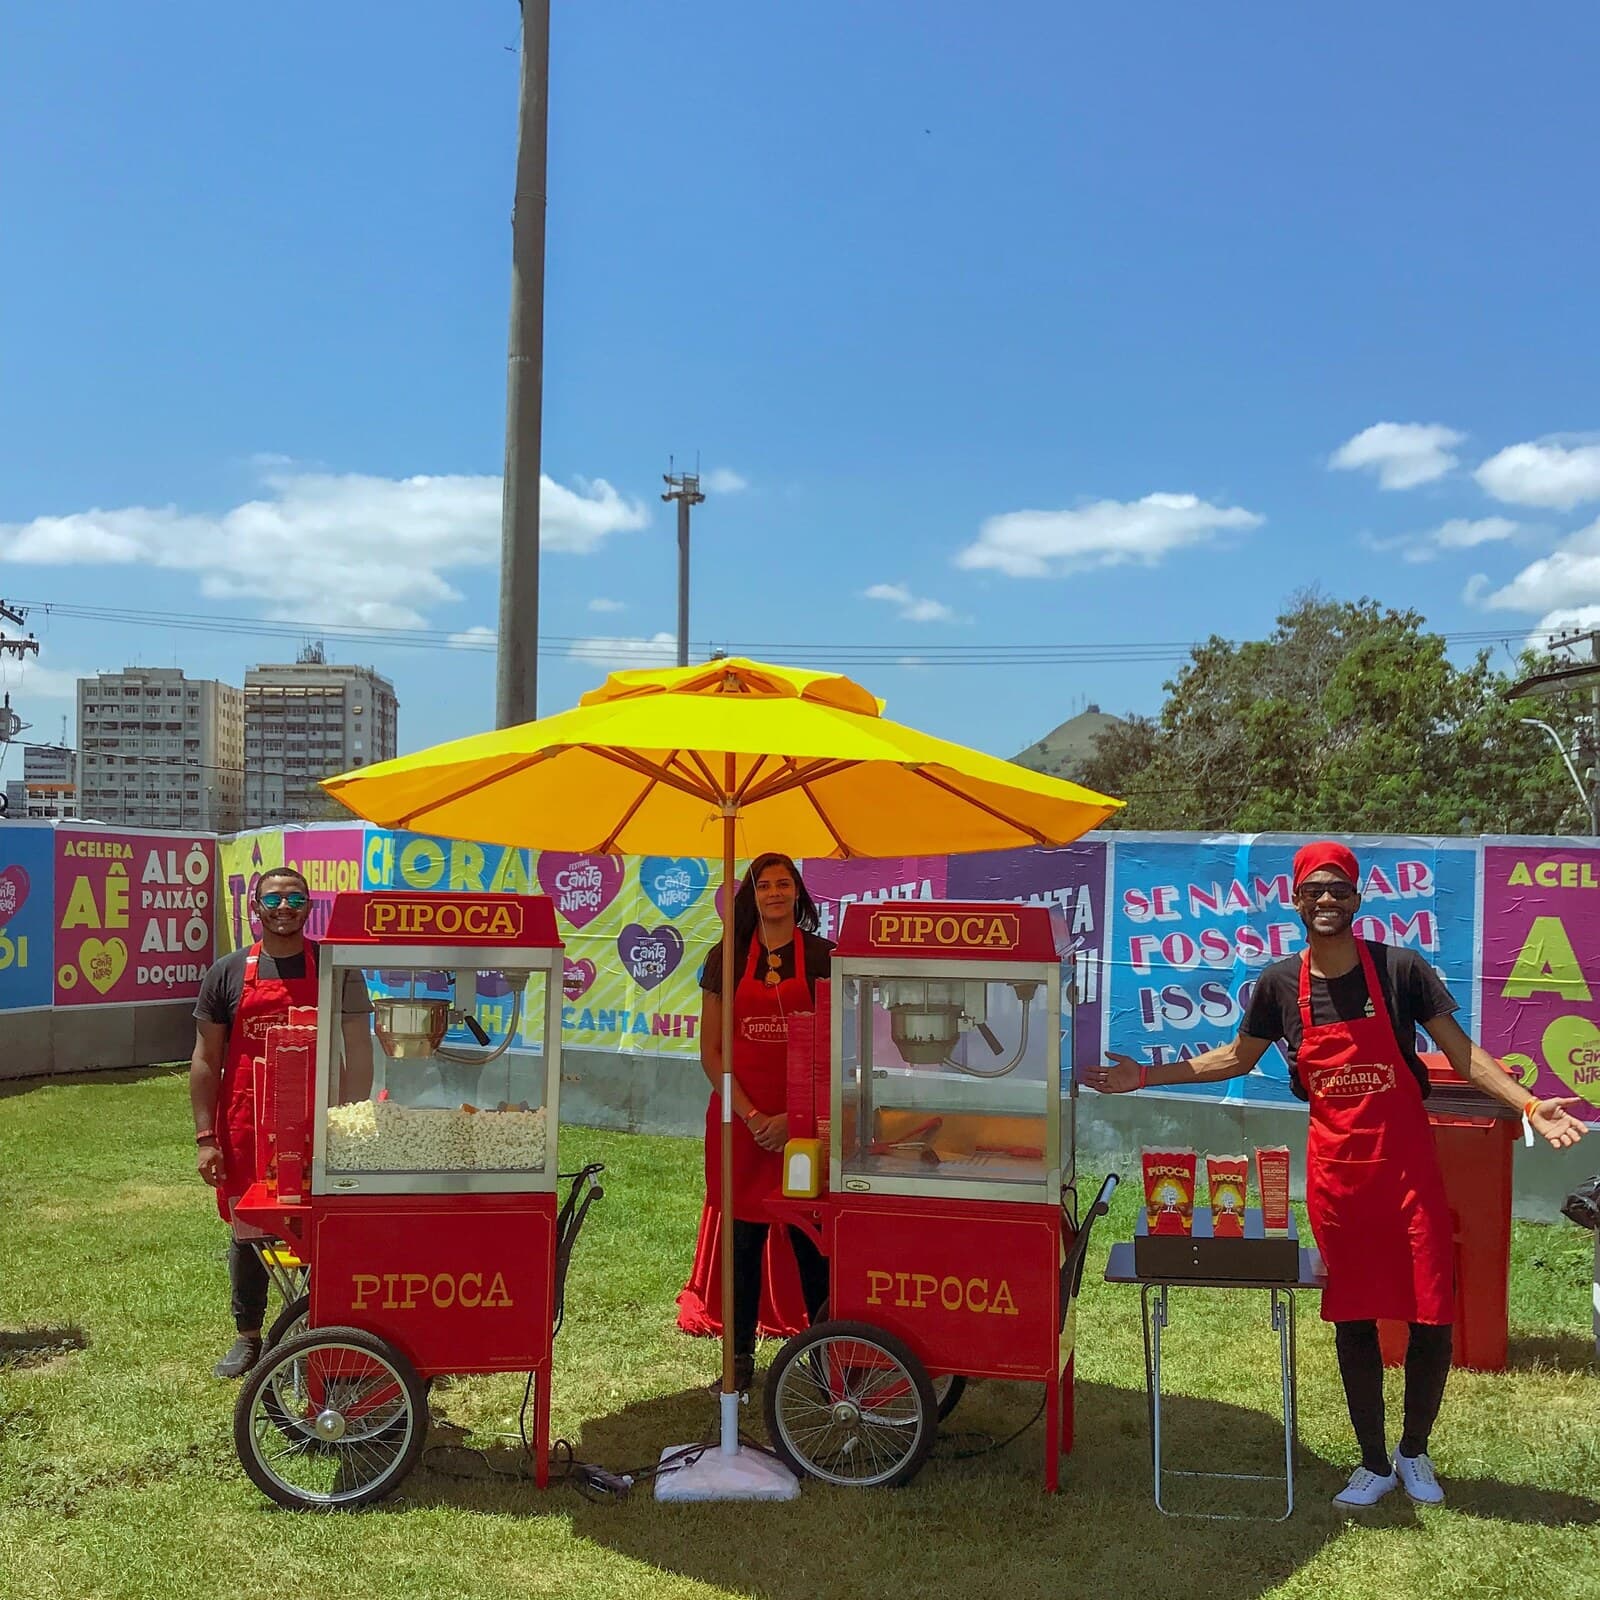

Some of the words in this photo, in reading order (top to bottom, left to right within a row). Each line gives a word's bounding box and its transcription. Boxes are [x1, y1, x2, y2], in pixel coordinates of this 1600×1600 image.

[64, 841, 134, 859] ACELERA
[141, 842, 210, 886] ALÔ
[366, 836, 530, 895] CHORA
[61, 862, 130, 929] AÊ
[142, 887, 208, 909] PAIXÃO
[1123, 885, 1180, 922] SE
[140, 908, 209, 953] ALÔ
[372, 904, 516, 934] PIPOCA
[877, 916, 1011, 946] PIPOCA
[1129, 923, 1302, 975] FOSSE
[58, 964, 78, 990] O
[137, 964, 208, 989] DOÇURA
[1321, 1072, 1382, 1088] PIPOCARIA
[1146, 1165, 1191, 1179] PIPOCA
[1211, 1173, 1243, 1184] PIPOCA
[352, 1272, 513, 1310] PIPOCA
[867, 1271, 1019, 1315] PIPOCA
